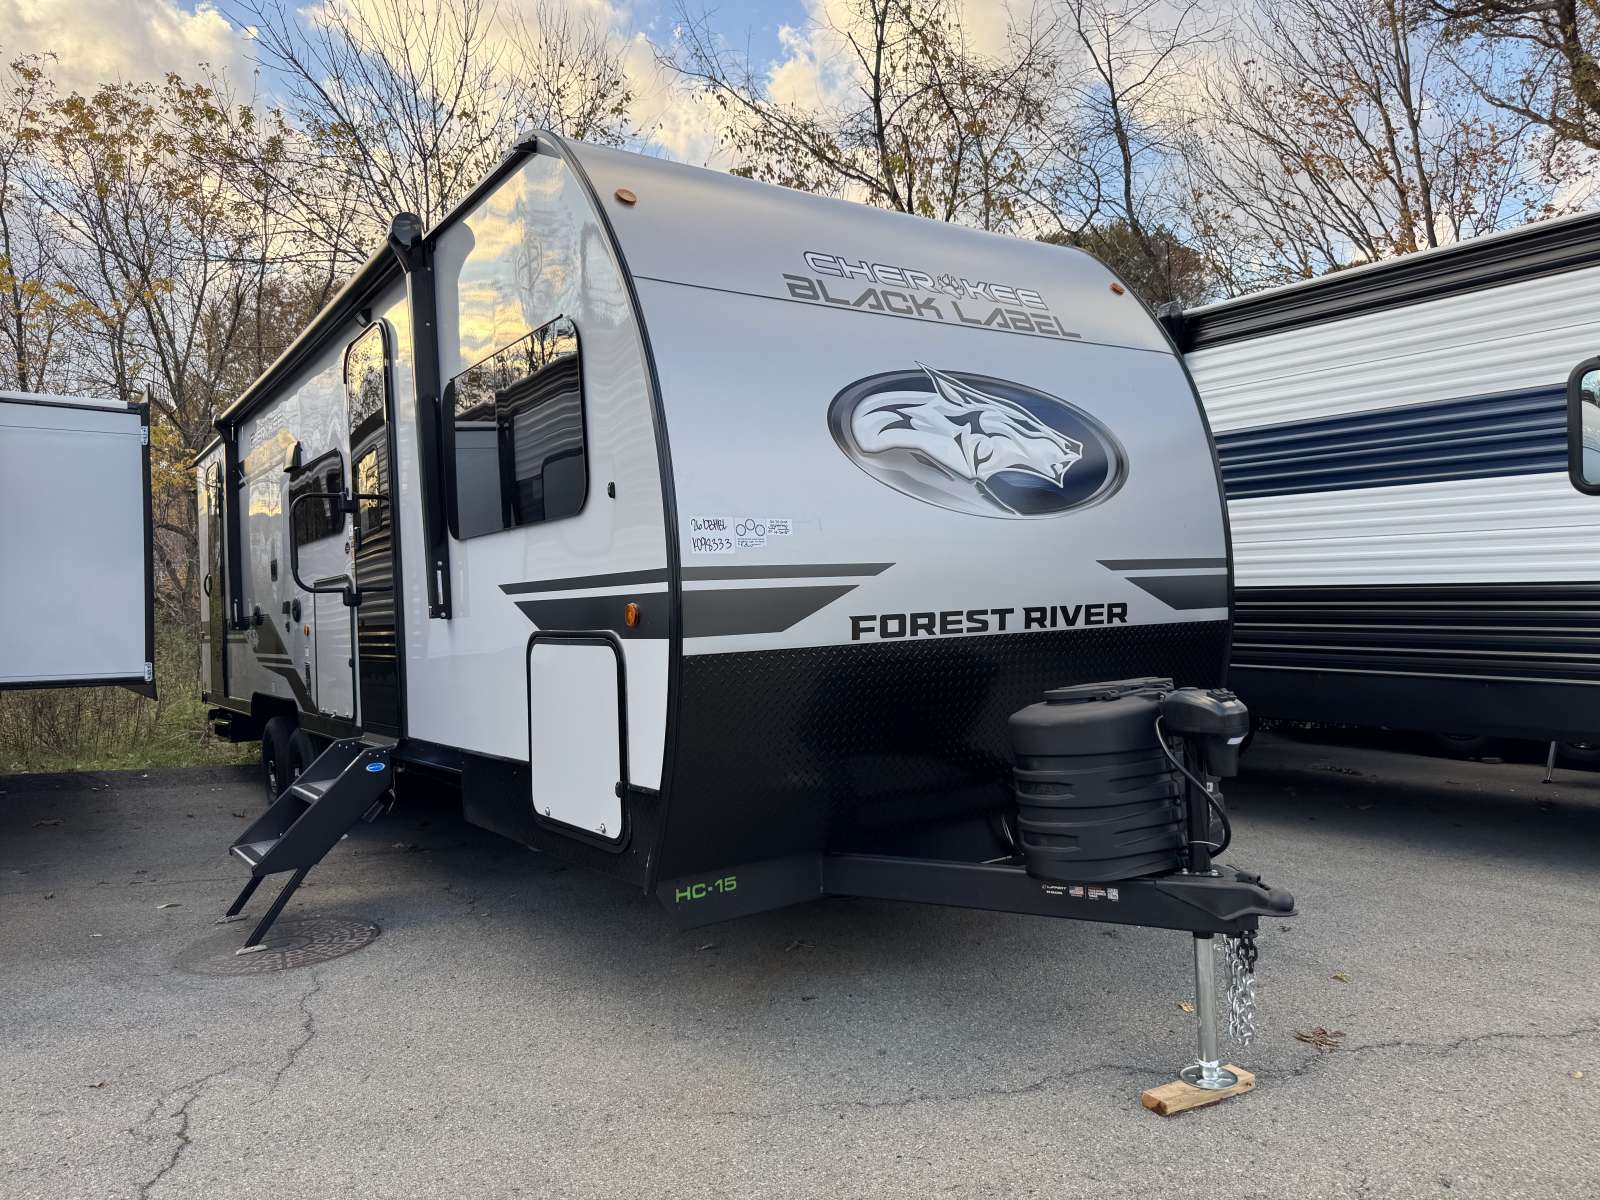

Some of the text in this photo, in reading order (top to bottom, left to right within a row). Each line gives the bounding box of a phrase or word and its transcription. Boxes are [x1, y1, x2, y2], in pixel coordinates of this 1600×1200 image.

[782, 273, 1082, 339] BLACK LABEL
[849, 602, 1128, 640] FOREST RIVER
